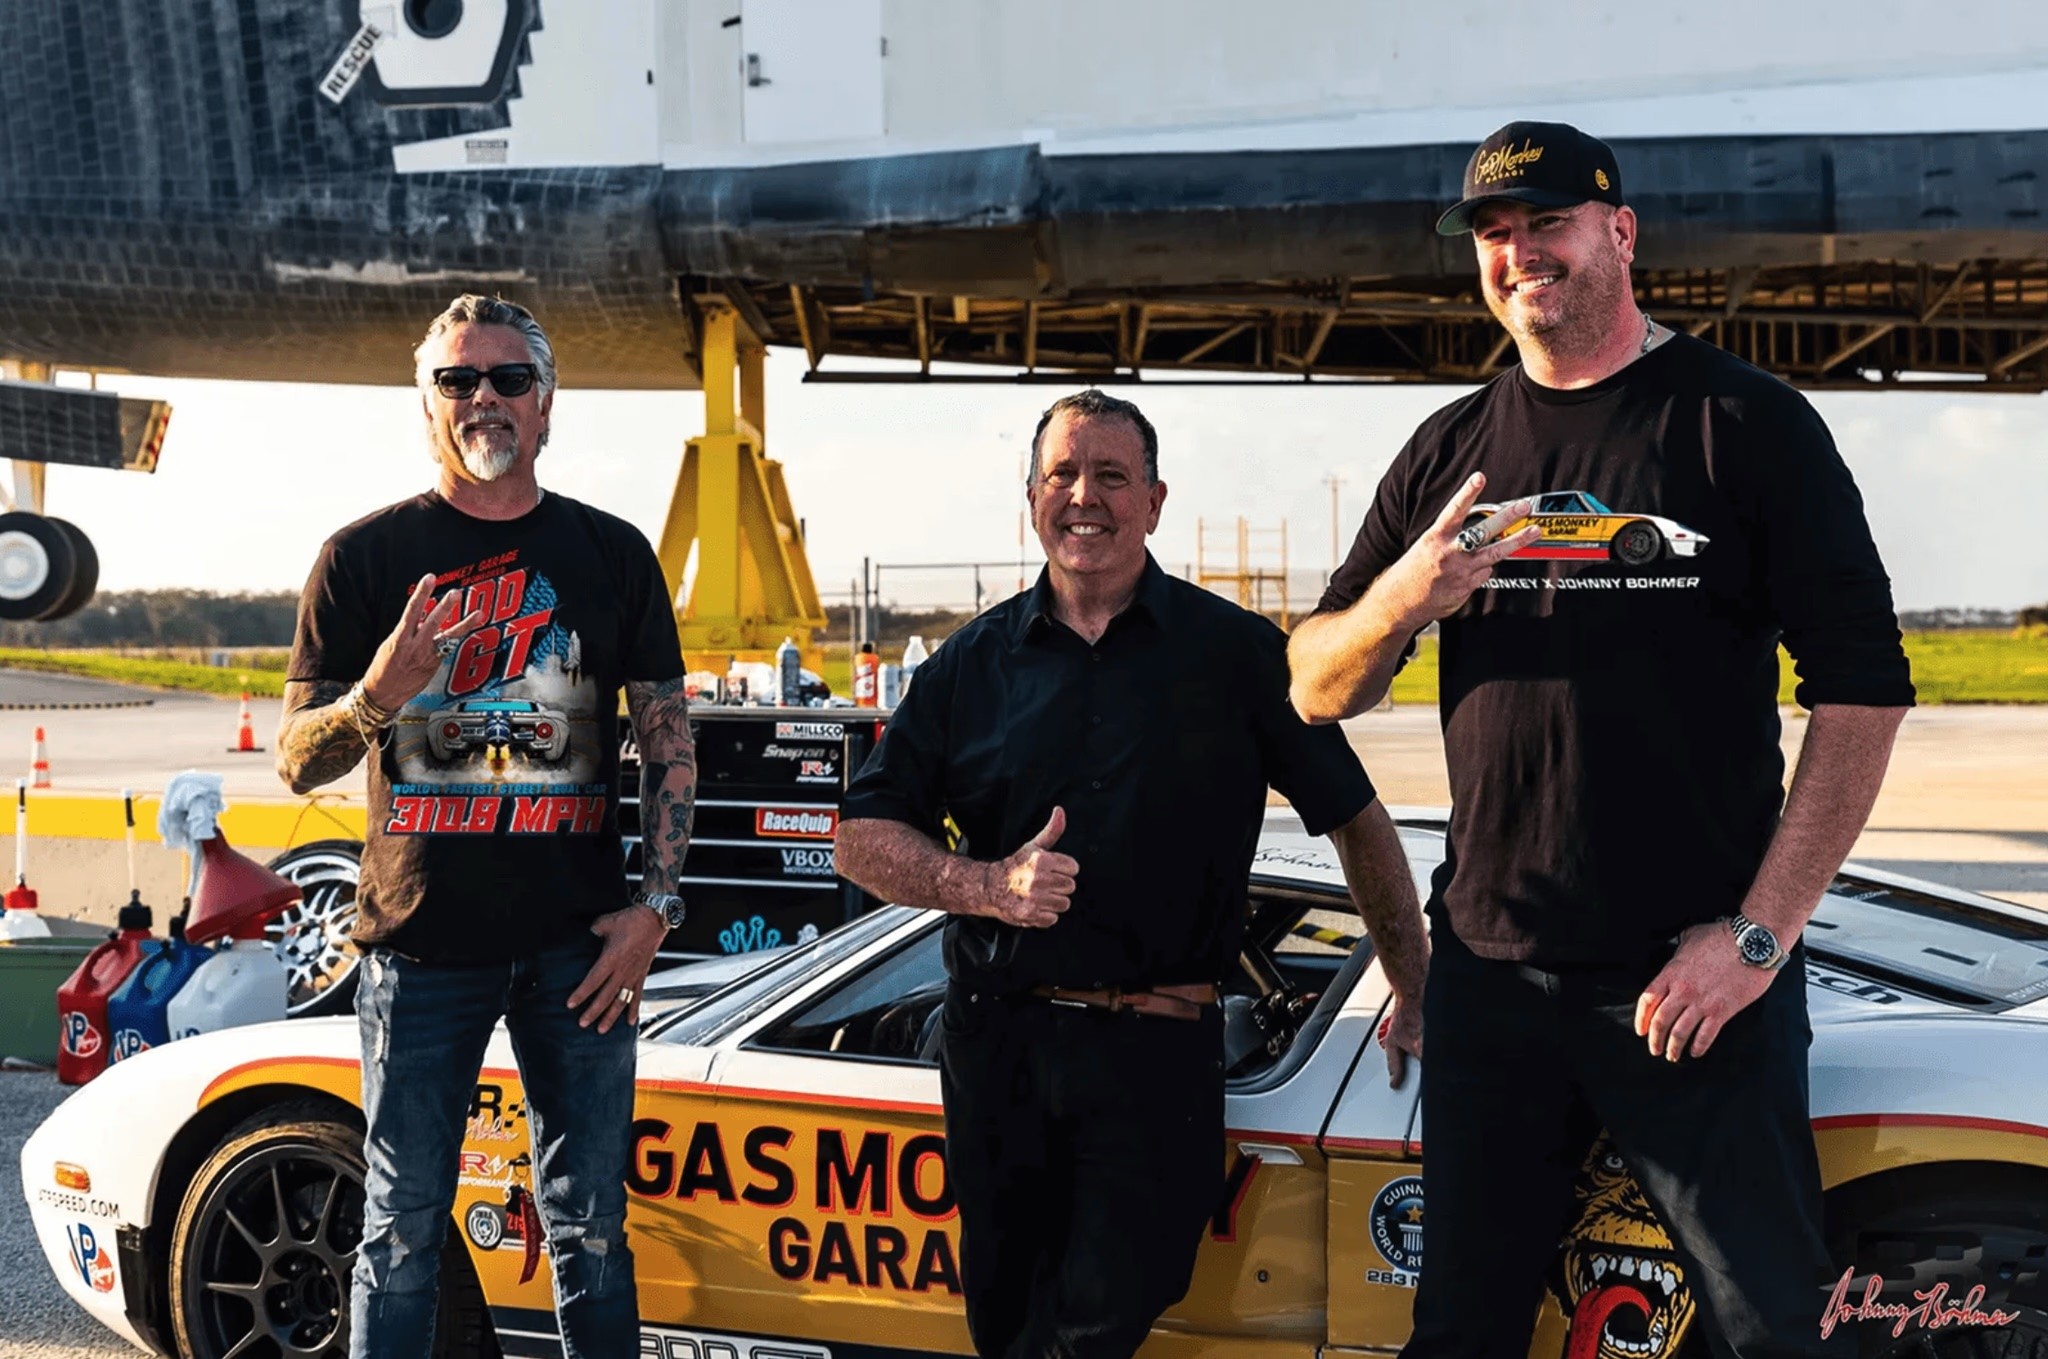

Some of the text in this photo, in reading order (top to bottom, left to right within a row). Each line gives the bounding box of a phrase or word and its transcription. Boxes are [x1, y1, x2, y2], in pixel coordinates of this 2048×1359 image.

[327, 24, 382, 95] RESCUE
[1555, 517, 1598, 528] MONKEY
[1541, 578, 1555, 589] X
[1557, 577, 1621, 589] JOHNNY
[1626, 577, 1700, 589] BOHMER
[448, 608, 553, 697] GT
[794, 724, 843, 737] MILLSCO
[762, 744, 825, 761] Snap-on
[444, 783, 495, 795] FASTEST
[499, 783, 544, 795] STREET
[548, 783, 581, 795] LEGAL
[585, 783, 608, 795] CAR
[386, 796, 606, 833] 310.8 MPH
[763, 811, 832, 834] RaceQuip
[781, 849, 835, 868] VBOX
[783, 867, 836, 876] MOTORSPOR
[627, 1118, 798, 1210] GAS
[1383, 1183, 1424, 1206] GUINN
[1376, 1215, 1404, 1261] WORLD
[768, 1217, 965, 1297] GARA
[1367, 1269, 1407, 1286] 283
